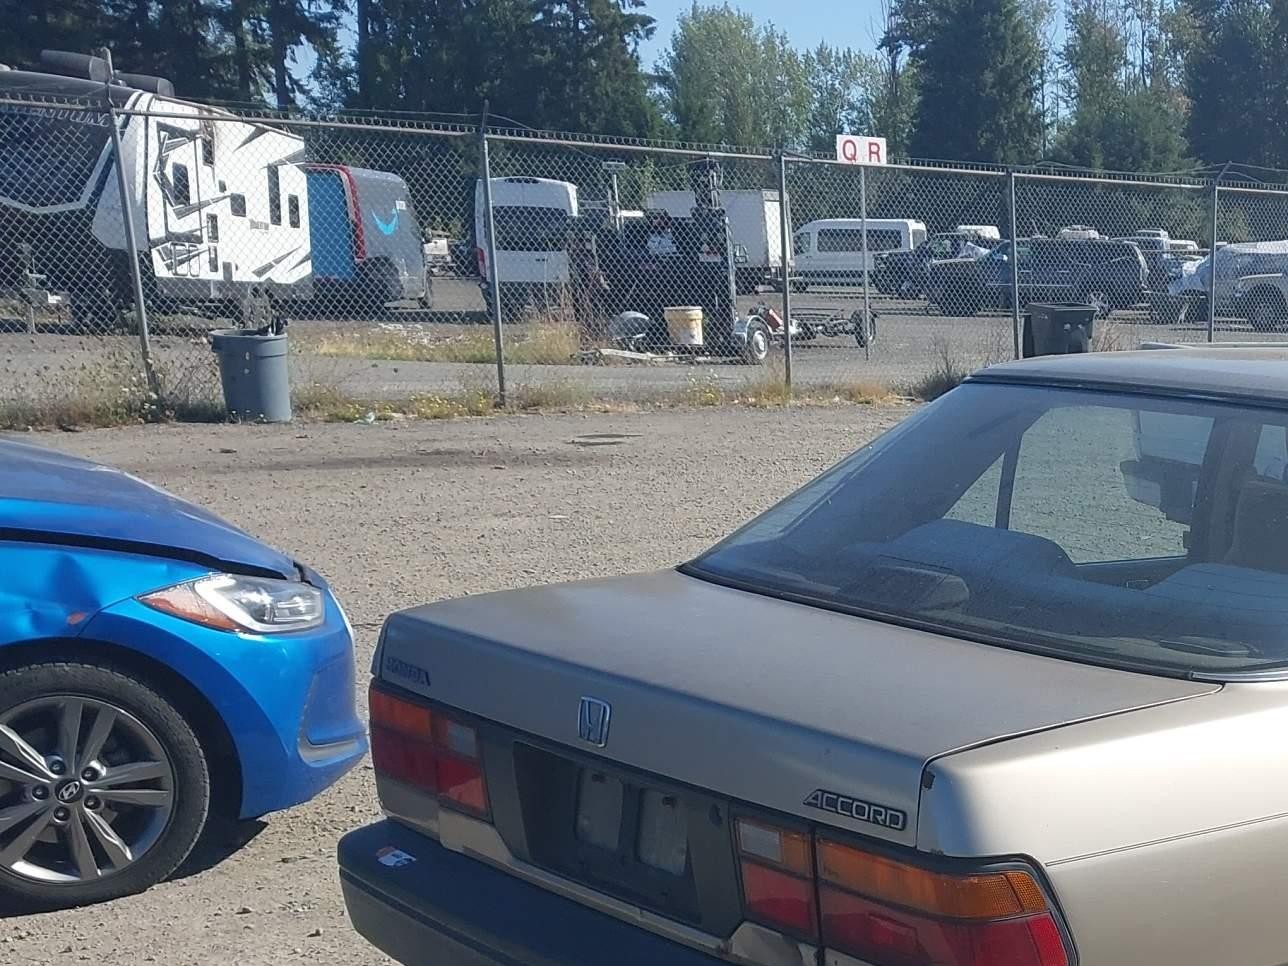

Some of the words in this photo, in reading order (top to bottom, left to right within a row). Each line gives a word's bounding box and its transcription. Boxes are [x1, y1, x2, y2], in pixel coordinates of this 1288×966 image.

[842, 139, 857, 164] Q
[868, 141, 881, 162] R
[803, 789, 905, 830] ACCORD
